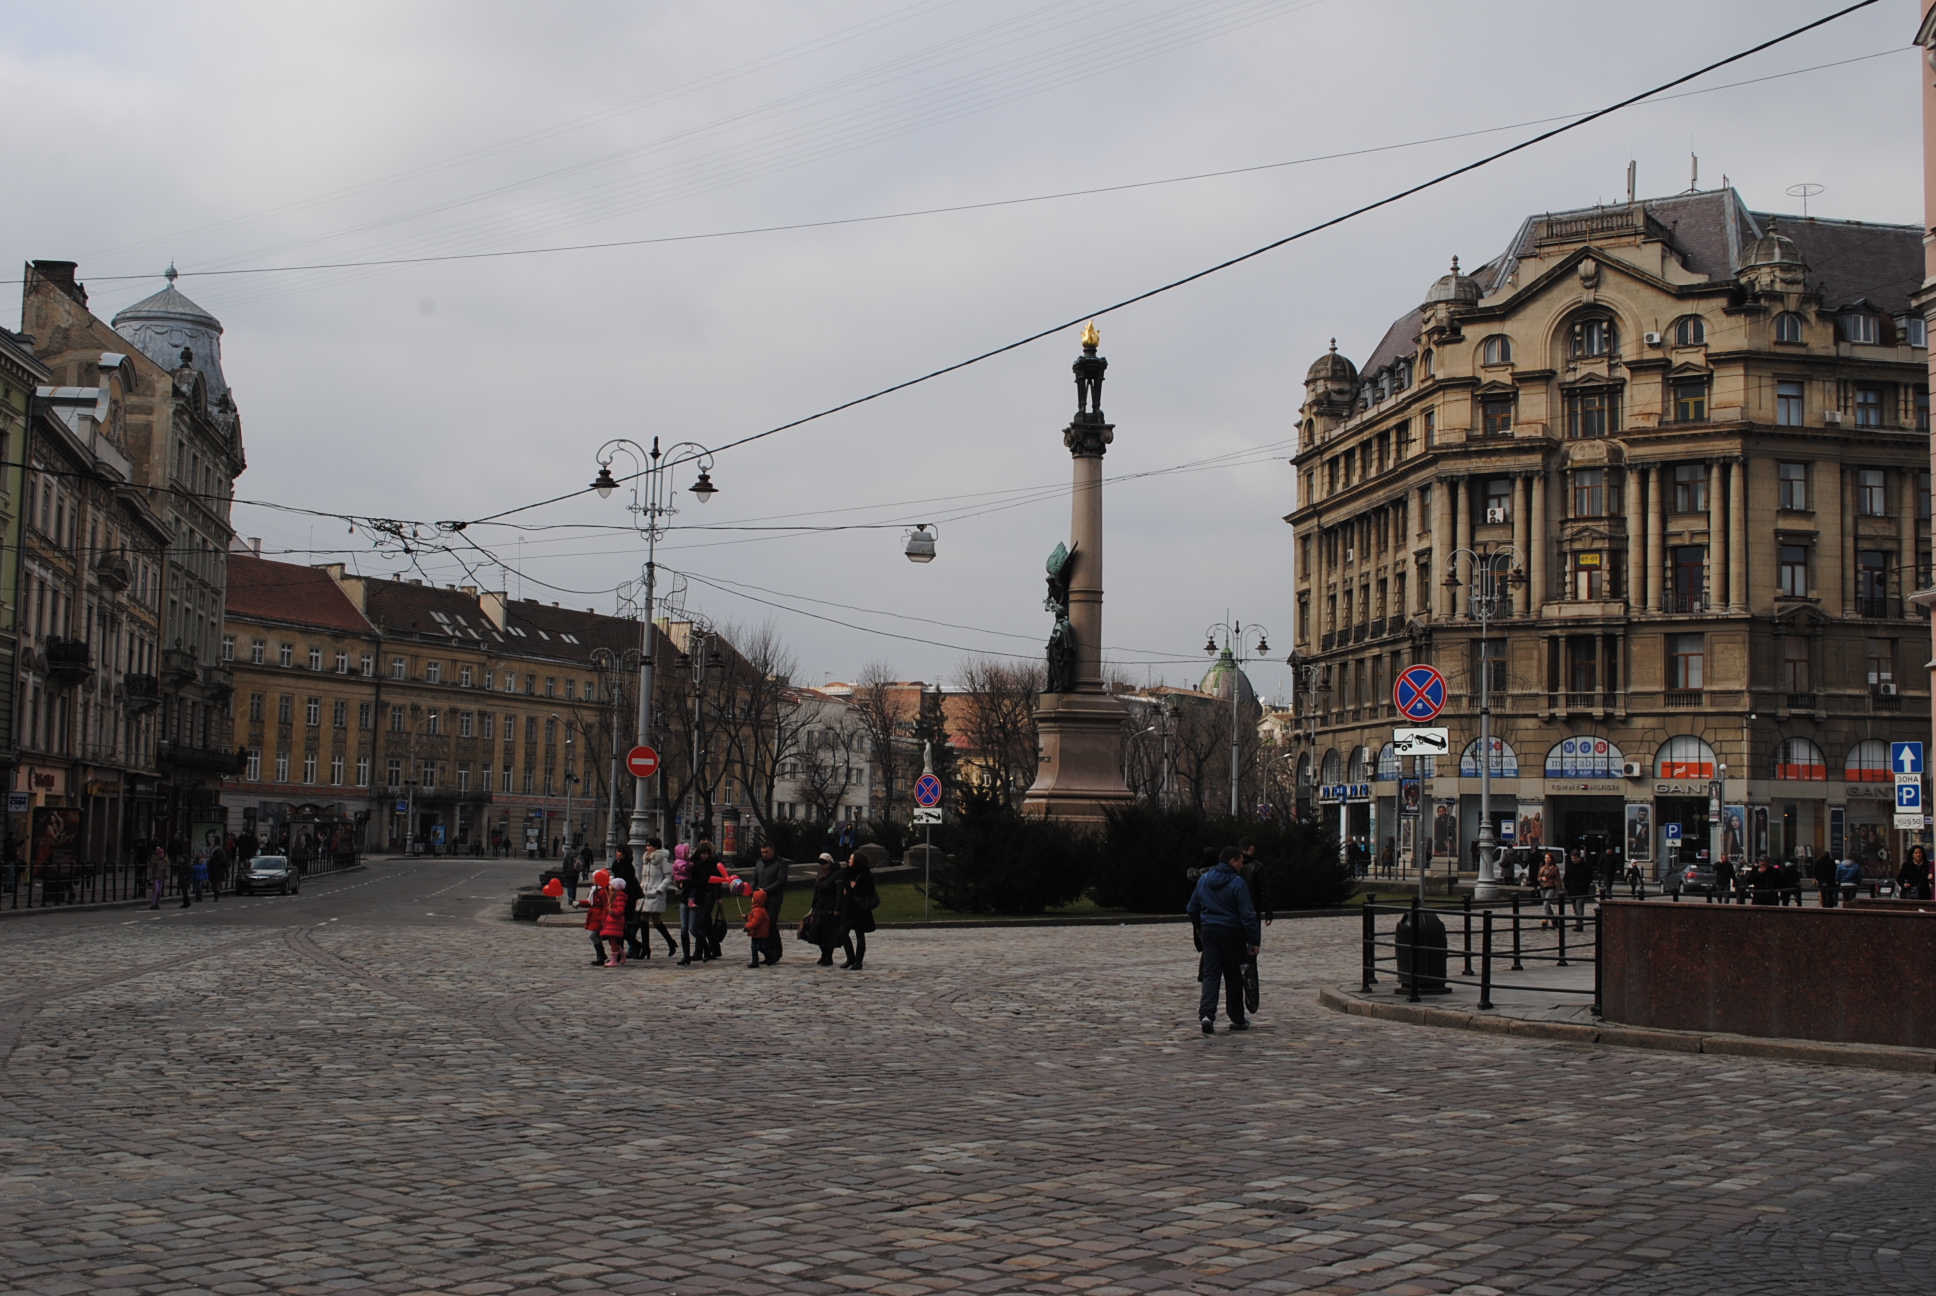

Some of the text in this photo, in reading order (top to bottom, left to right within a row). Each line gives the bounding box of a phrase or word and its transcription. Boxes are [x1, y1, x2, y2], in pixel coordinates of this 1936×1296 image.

[1565, 743, 1604, 752] M G B
[1551, 757, 1616, 770] megabank
[1897, 775, 1919, 783] ЗОНА
[1902, 787, 1915, 805] P
[1668, 824, 1678, 838] P
